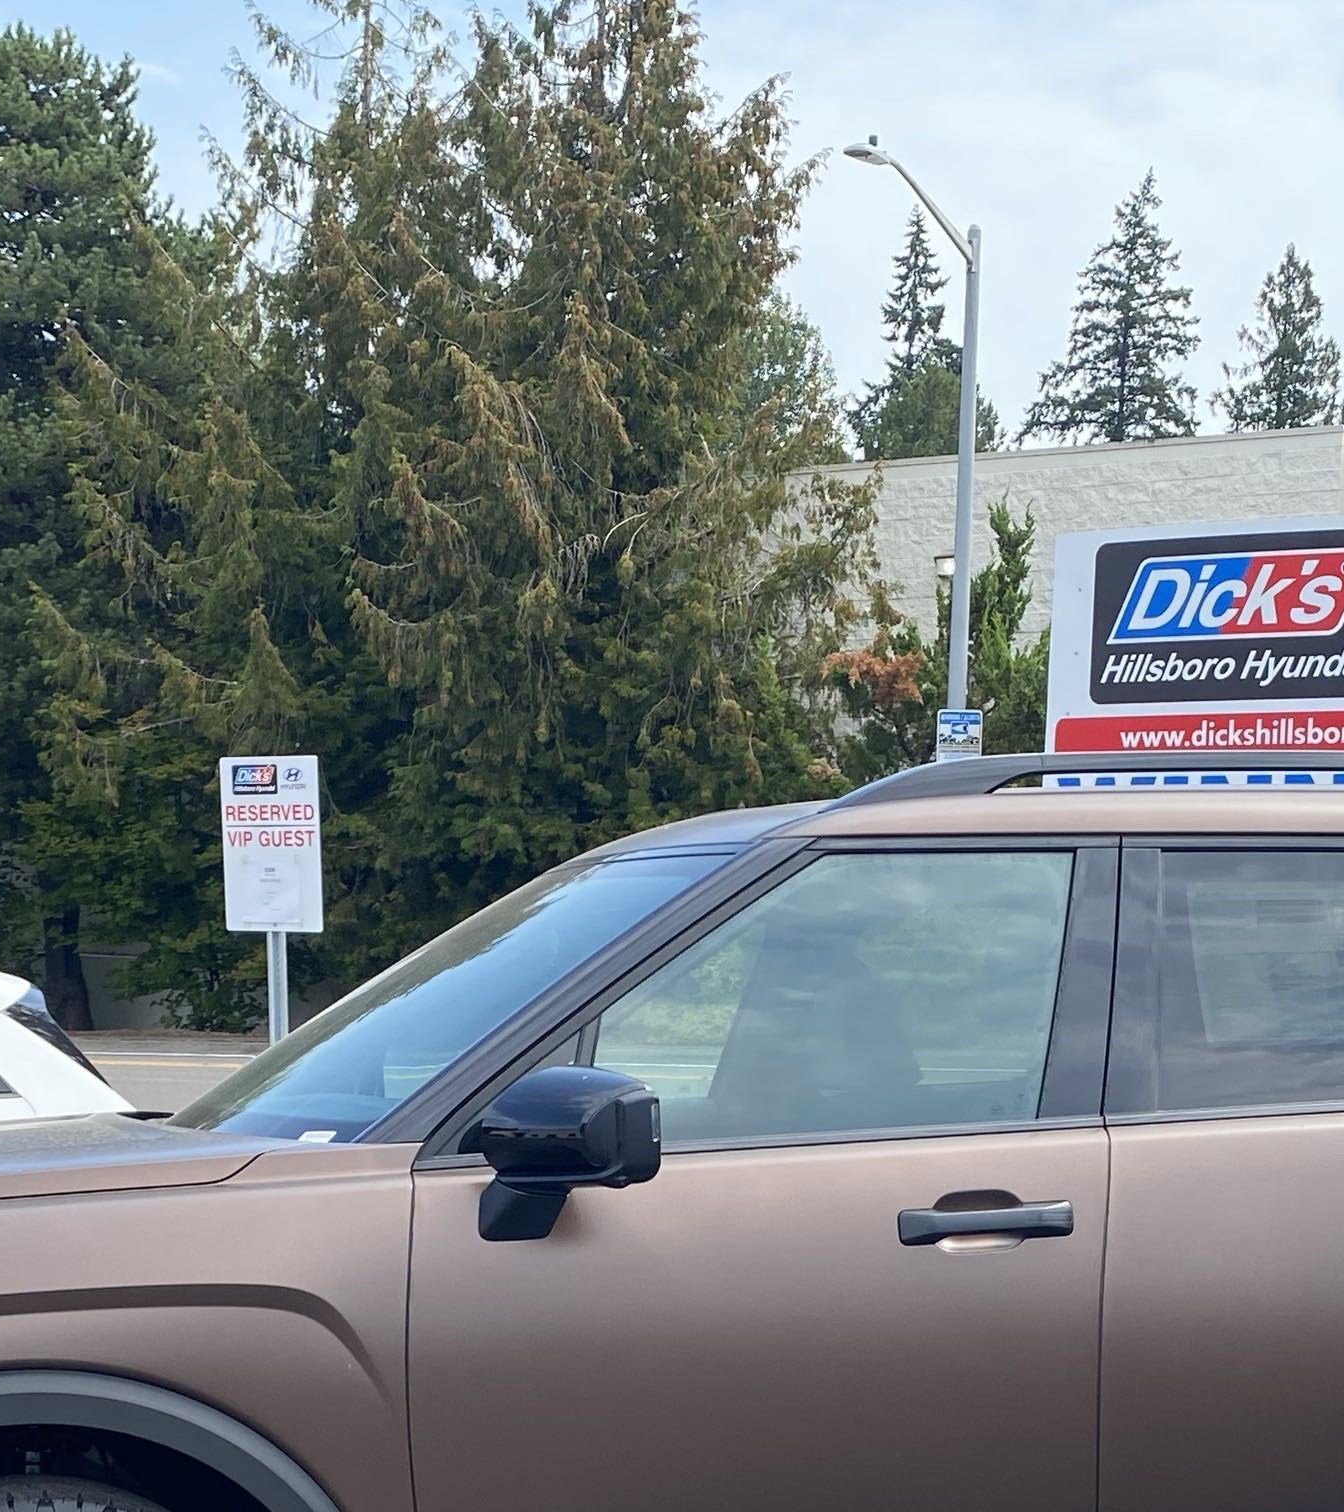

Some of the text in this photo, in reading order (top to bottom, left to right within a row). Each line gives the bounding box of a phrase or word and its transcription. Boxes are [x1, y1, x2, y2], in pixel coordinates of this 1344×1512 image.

[1127, 560, 1342, 631] Dick's
[1100, 652, 1236, 683] Hillsboro
[225, 804, 315, 822] RESERVED
[227, 831, 316, 847] VIP GUEST
